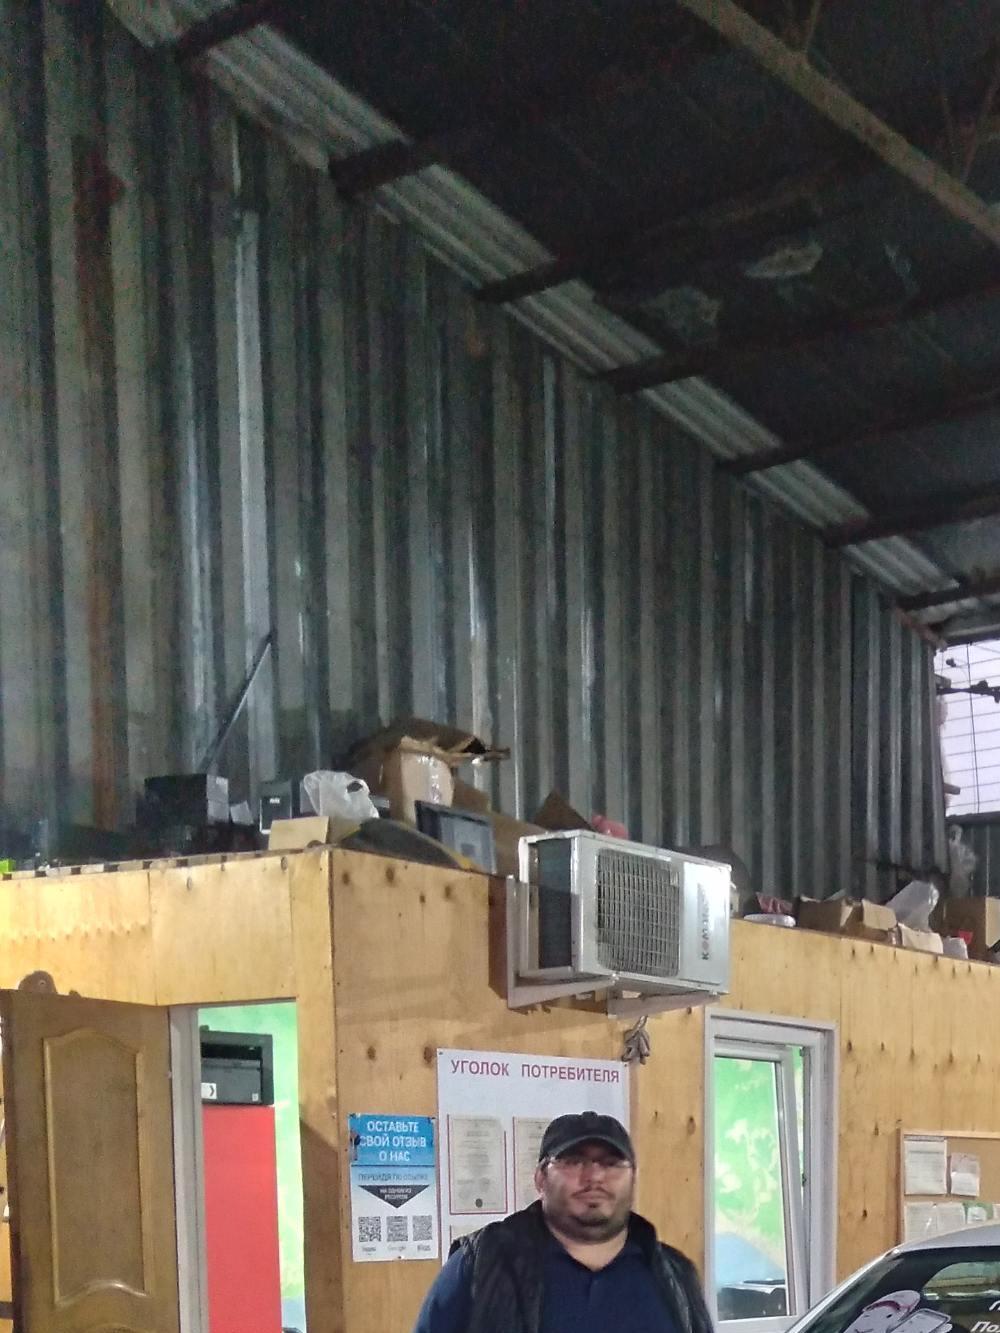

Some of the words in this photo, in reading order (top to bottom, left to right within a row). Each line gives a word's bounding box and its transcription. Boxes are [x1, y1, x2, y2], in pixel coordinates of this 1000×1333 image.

[451, 1060, 509, 1077] УГОЛОК
[521, 1064, 620, 1083] ПОТРЕБИТЕЛЯ
[366, 1121, 419, 1133] ОСТАВЬТЕ
[359, 1134, 389, 1147] СВОЙ
[393, 1137, 427, 1148] ОТЗЫВ
[379, 1151, 388, 1162] О
[389, 1151, 411, 1162] НАС
